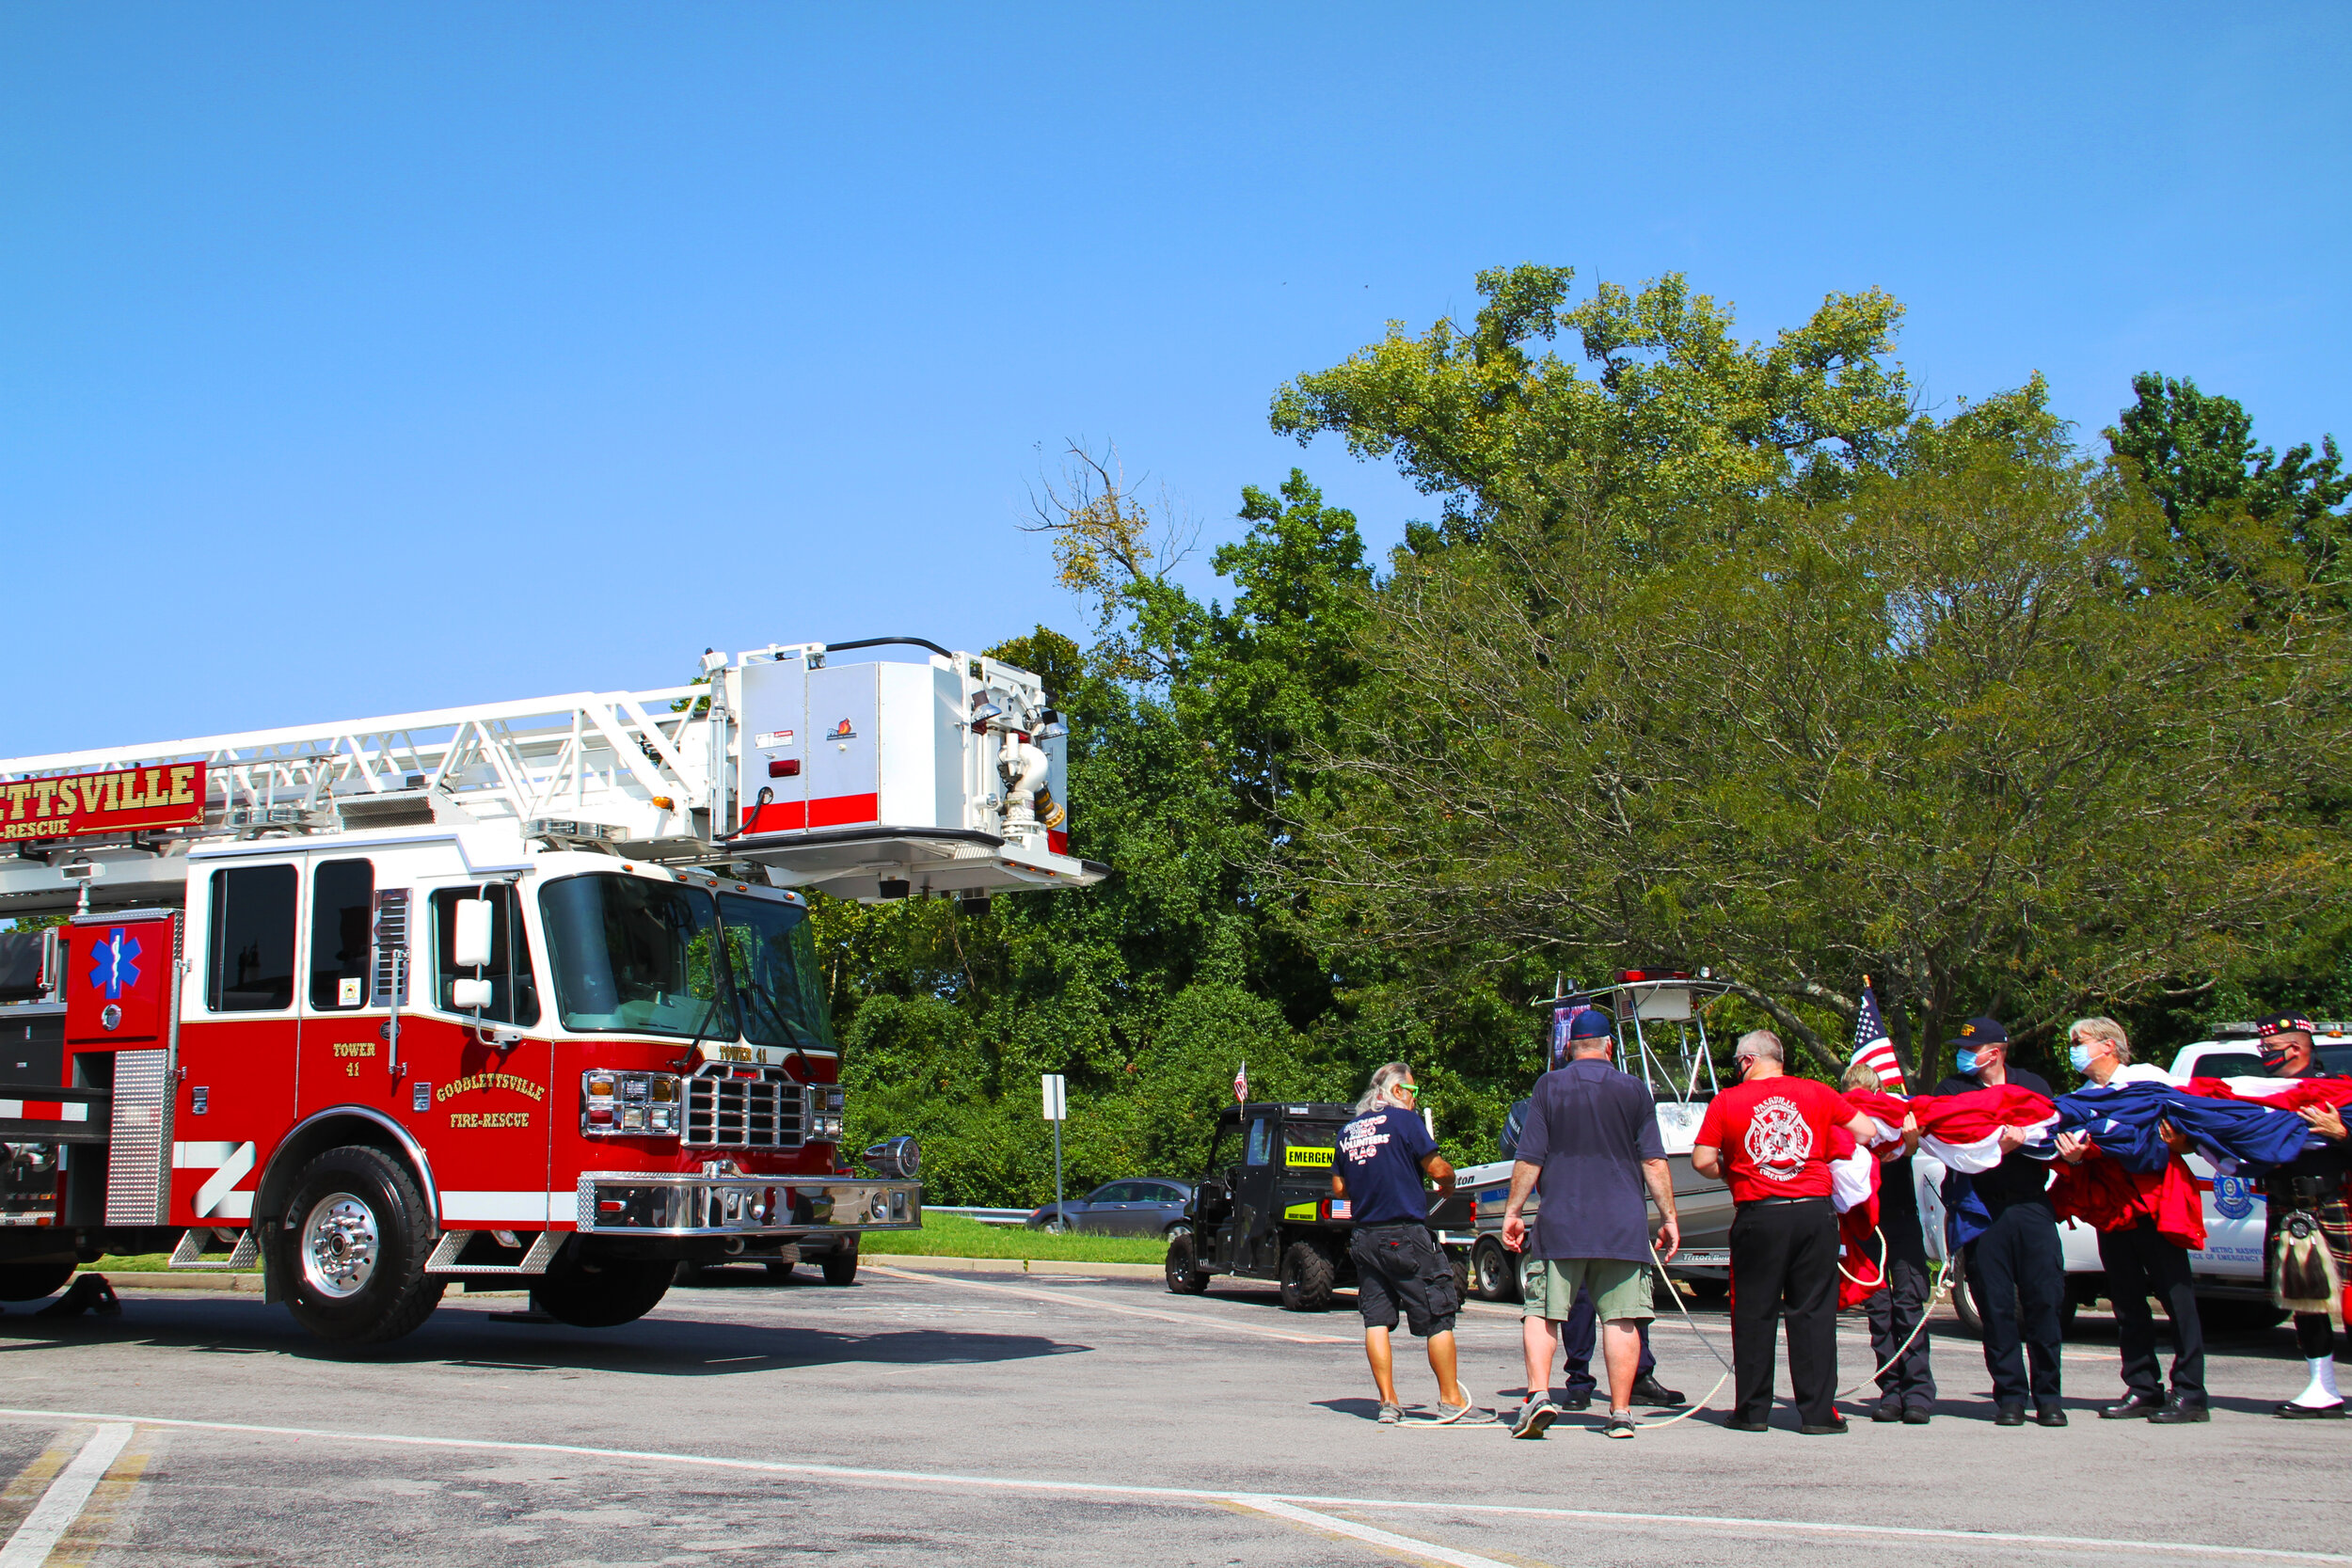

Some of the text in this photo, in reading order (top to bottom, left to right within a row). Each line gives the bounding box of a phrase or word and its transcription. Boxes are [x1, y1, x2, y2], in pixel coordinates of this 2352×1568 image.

[0, 766, 195, 821] TTSVILLE
[332, 1042, 376, 1057] TOWER
[720, 1045, 767, 1063] TOWER 41
[345, 1061, 360, 1077] 41
[436, 1072, 546, 1102] GOODLETTSVILLE
[1753, 1096, 1797, 1114] NASHVILLE
[450, 1112, 530, 1128] FIRE-RESCUE
[1289, 1151, 1333, 1164] EMERGEN
[1349, 1145, 1376, 1162] FLAG
